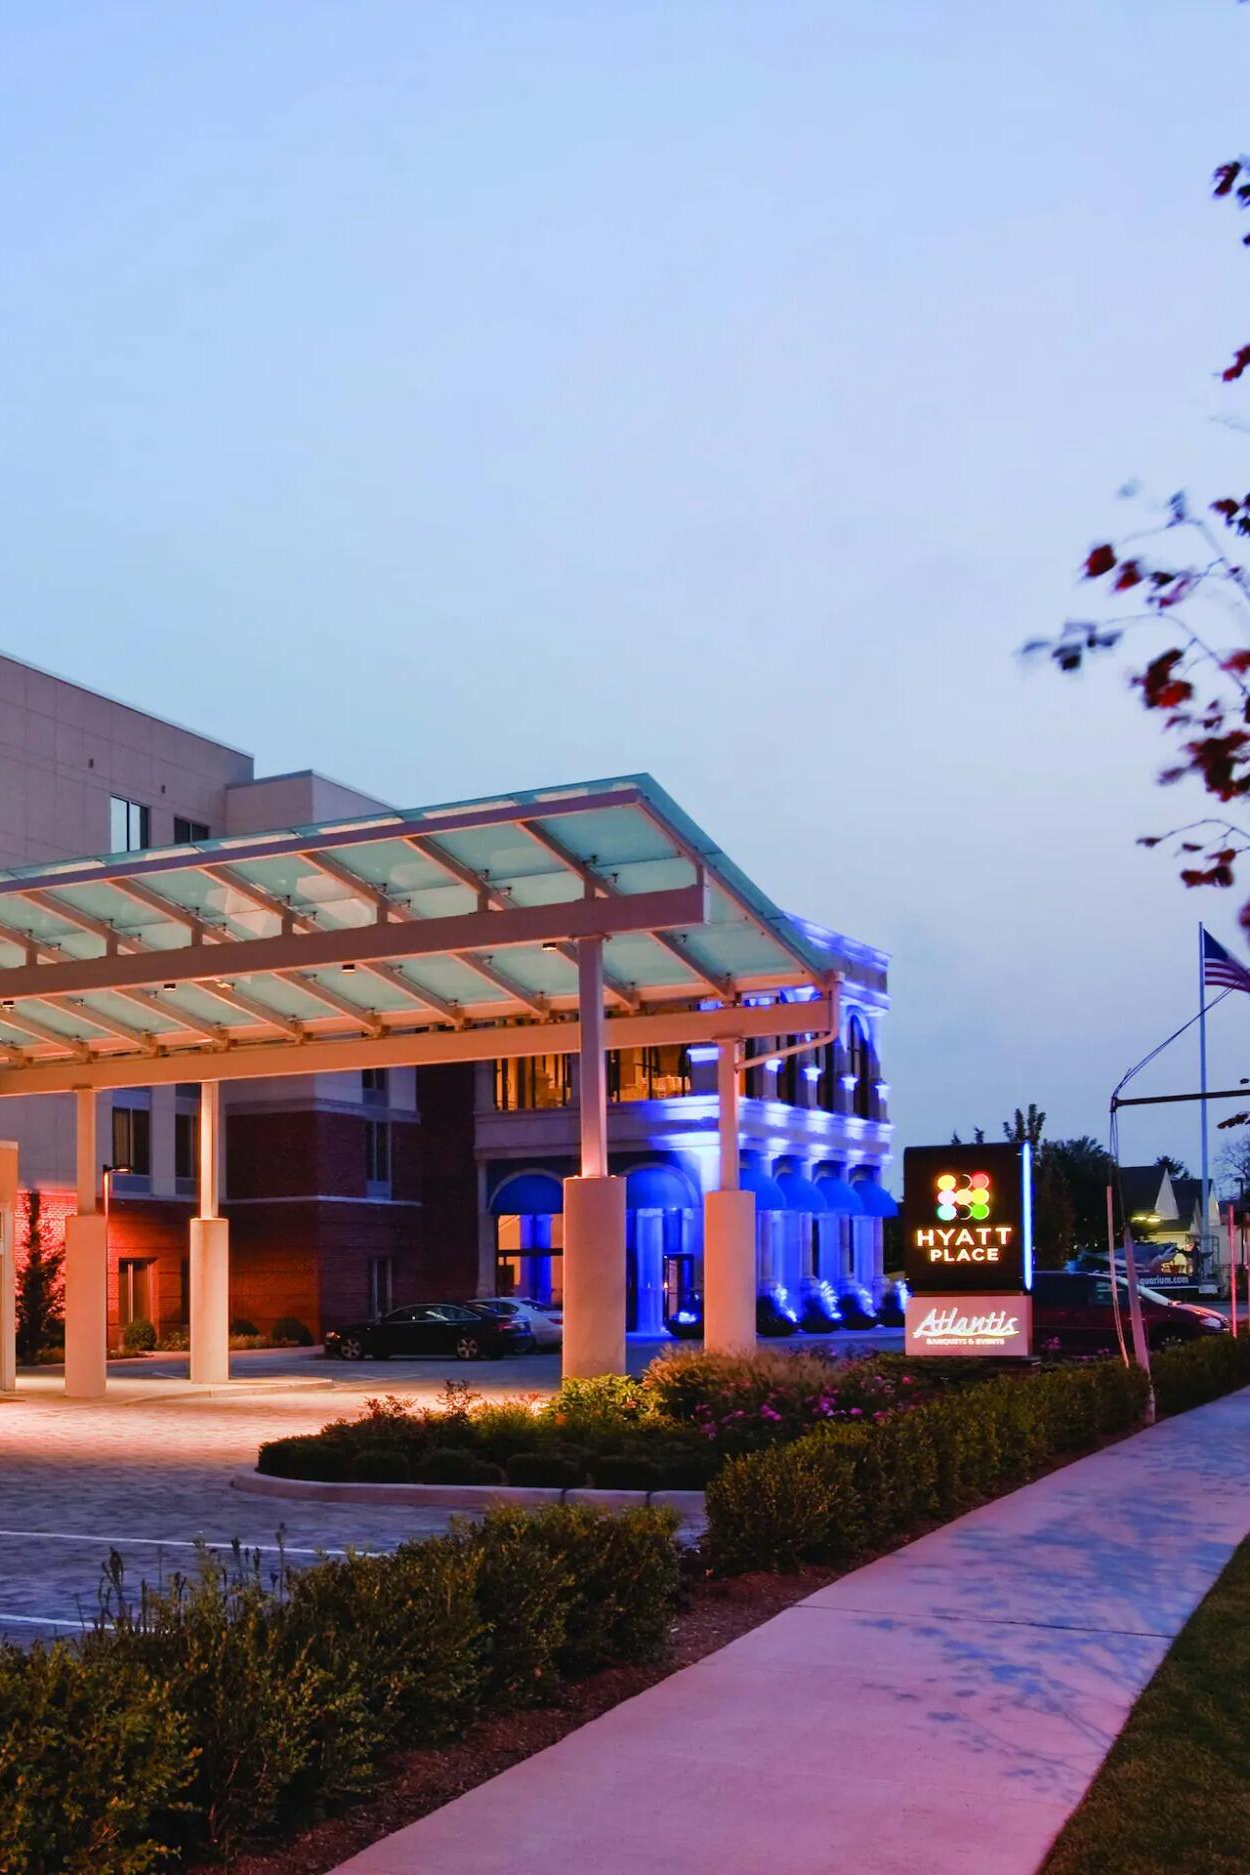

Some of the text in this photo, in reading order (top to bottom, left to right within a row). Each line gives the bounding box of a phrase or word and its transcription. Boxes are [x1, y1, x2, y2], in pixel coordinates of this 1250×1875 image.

[916, 1227, 1012, 1247] HYATT
[930, 1248, 1000, 1262] PLACE
[913, 1307, 1019, 1338] Atlantis
